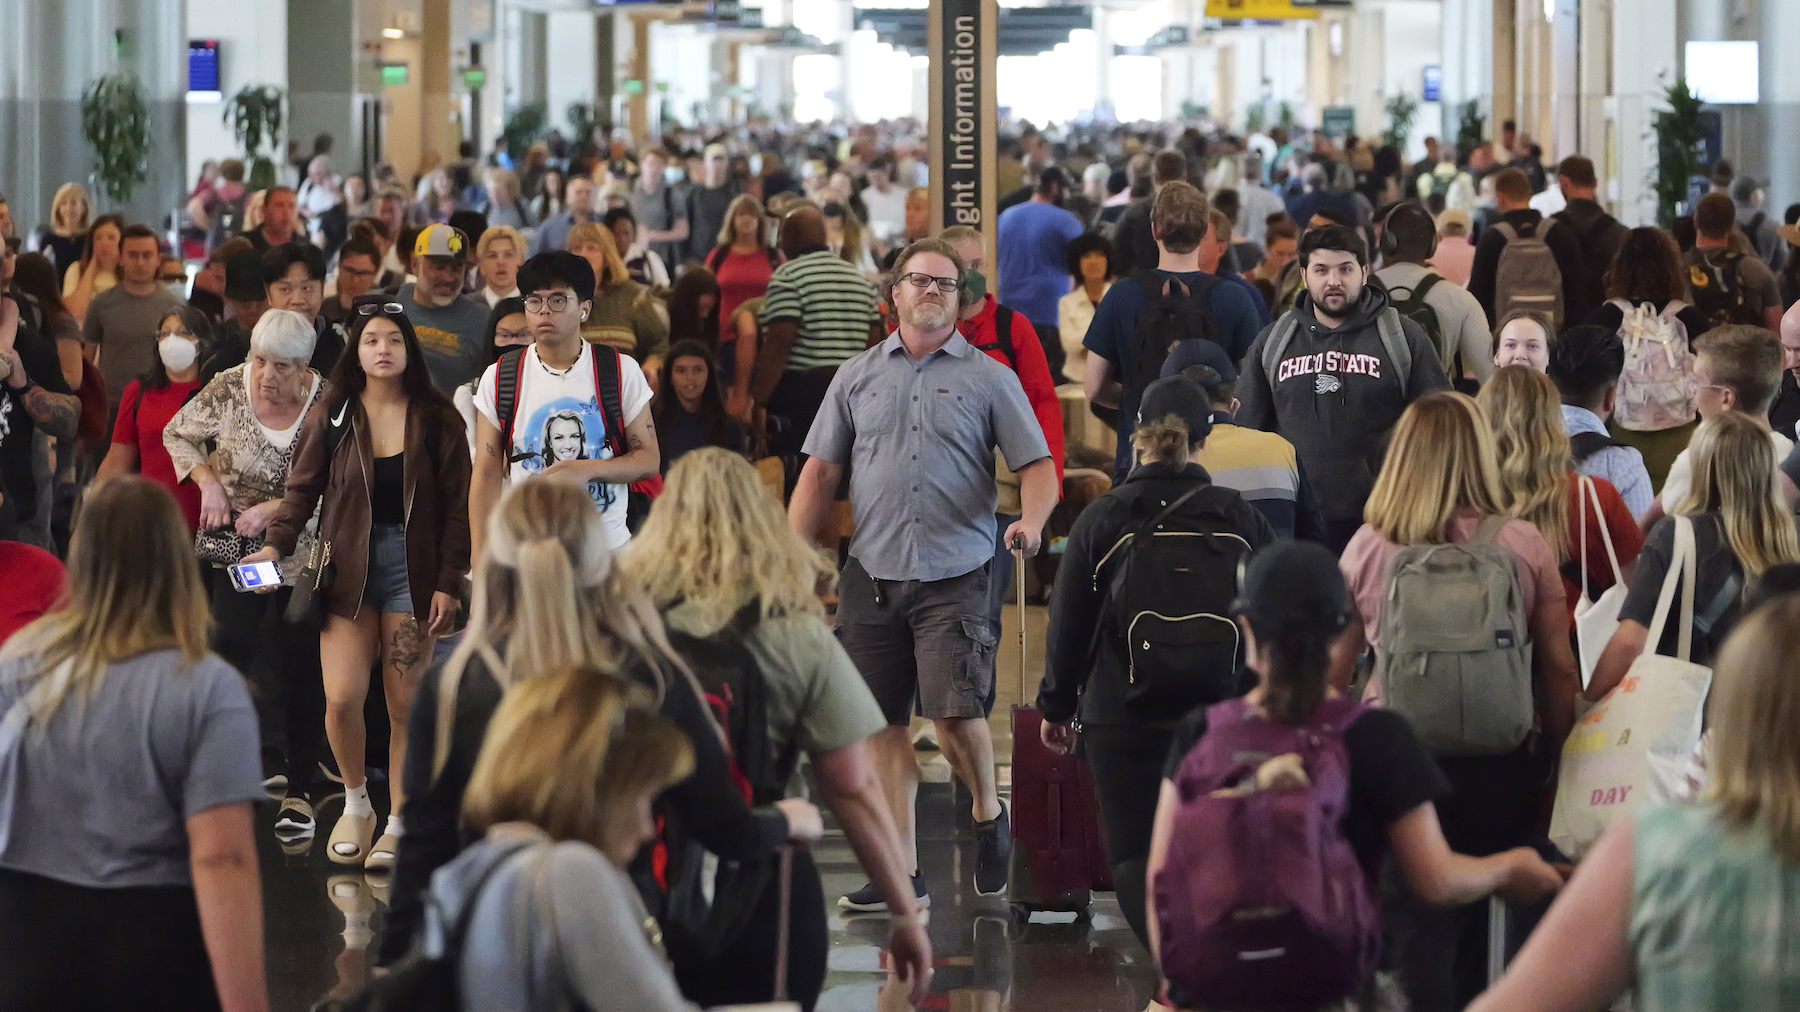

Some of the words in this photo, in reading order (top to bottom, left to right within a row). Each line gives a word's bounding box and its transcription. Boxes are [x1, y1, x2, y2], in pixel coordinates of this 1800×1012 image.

[950, 15, 975, 170] Information
[950, 180, 981, 228] ght
[1278, 352, 1323, 382] CHICO
[1325, 349, 1381, 379] STATE
[1616, 728, 1632, 746] A
[1590, 784, 1632, 806] DAY
